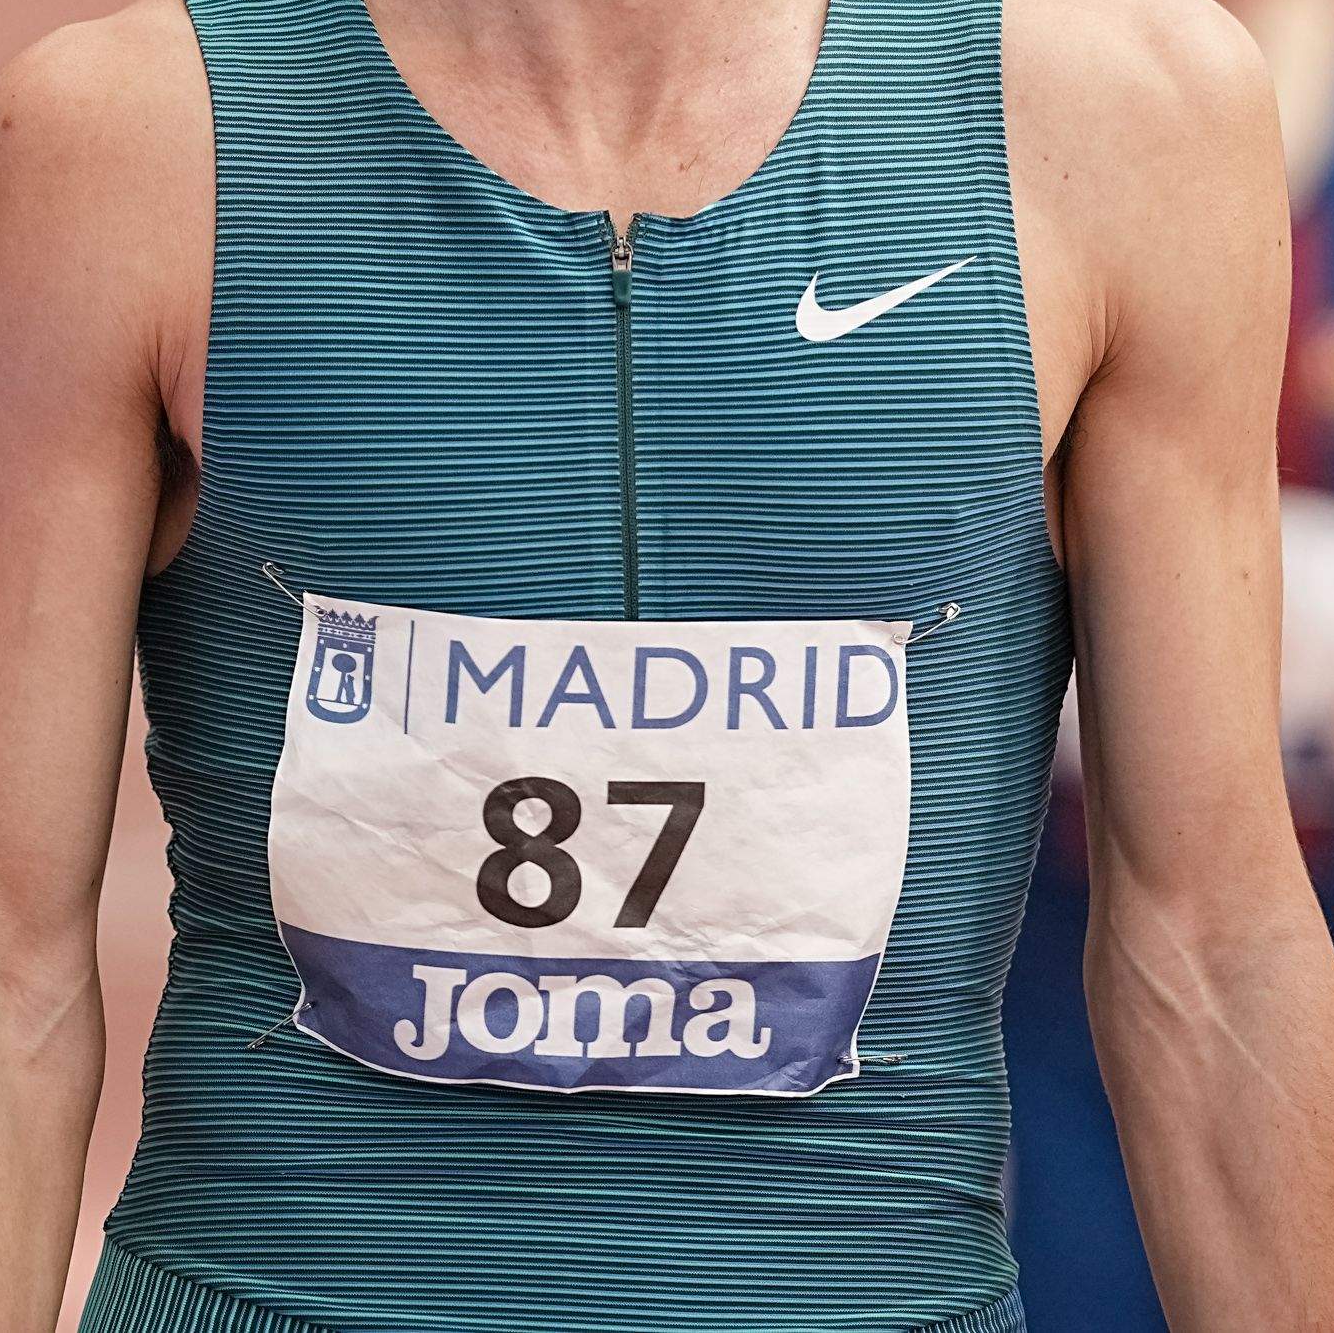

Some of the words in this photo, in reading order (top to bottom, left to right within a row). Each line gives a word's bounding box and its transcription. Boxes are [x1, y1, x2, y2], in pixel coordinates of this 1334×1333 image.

[446, 640, 899, 730] MADRID
[476, 776, 706, 928] 87
[393, 964, 770, 1060] Joma
